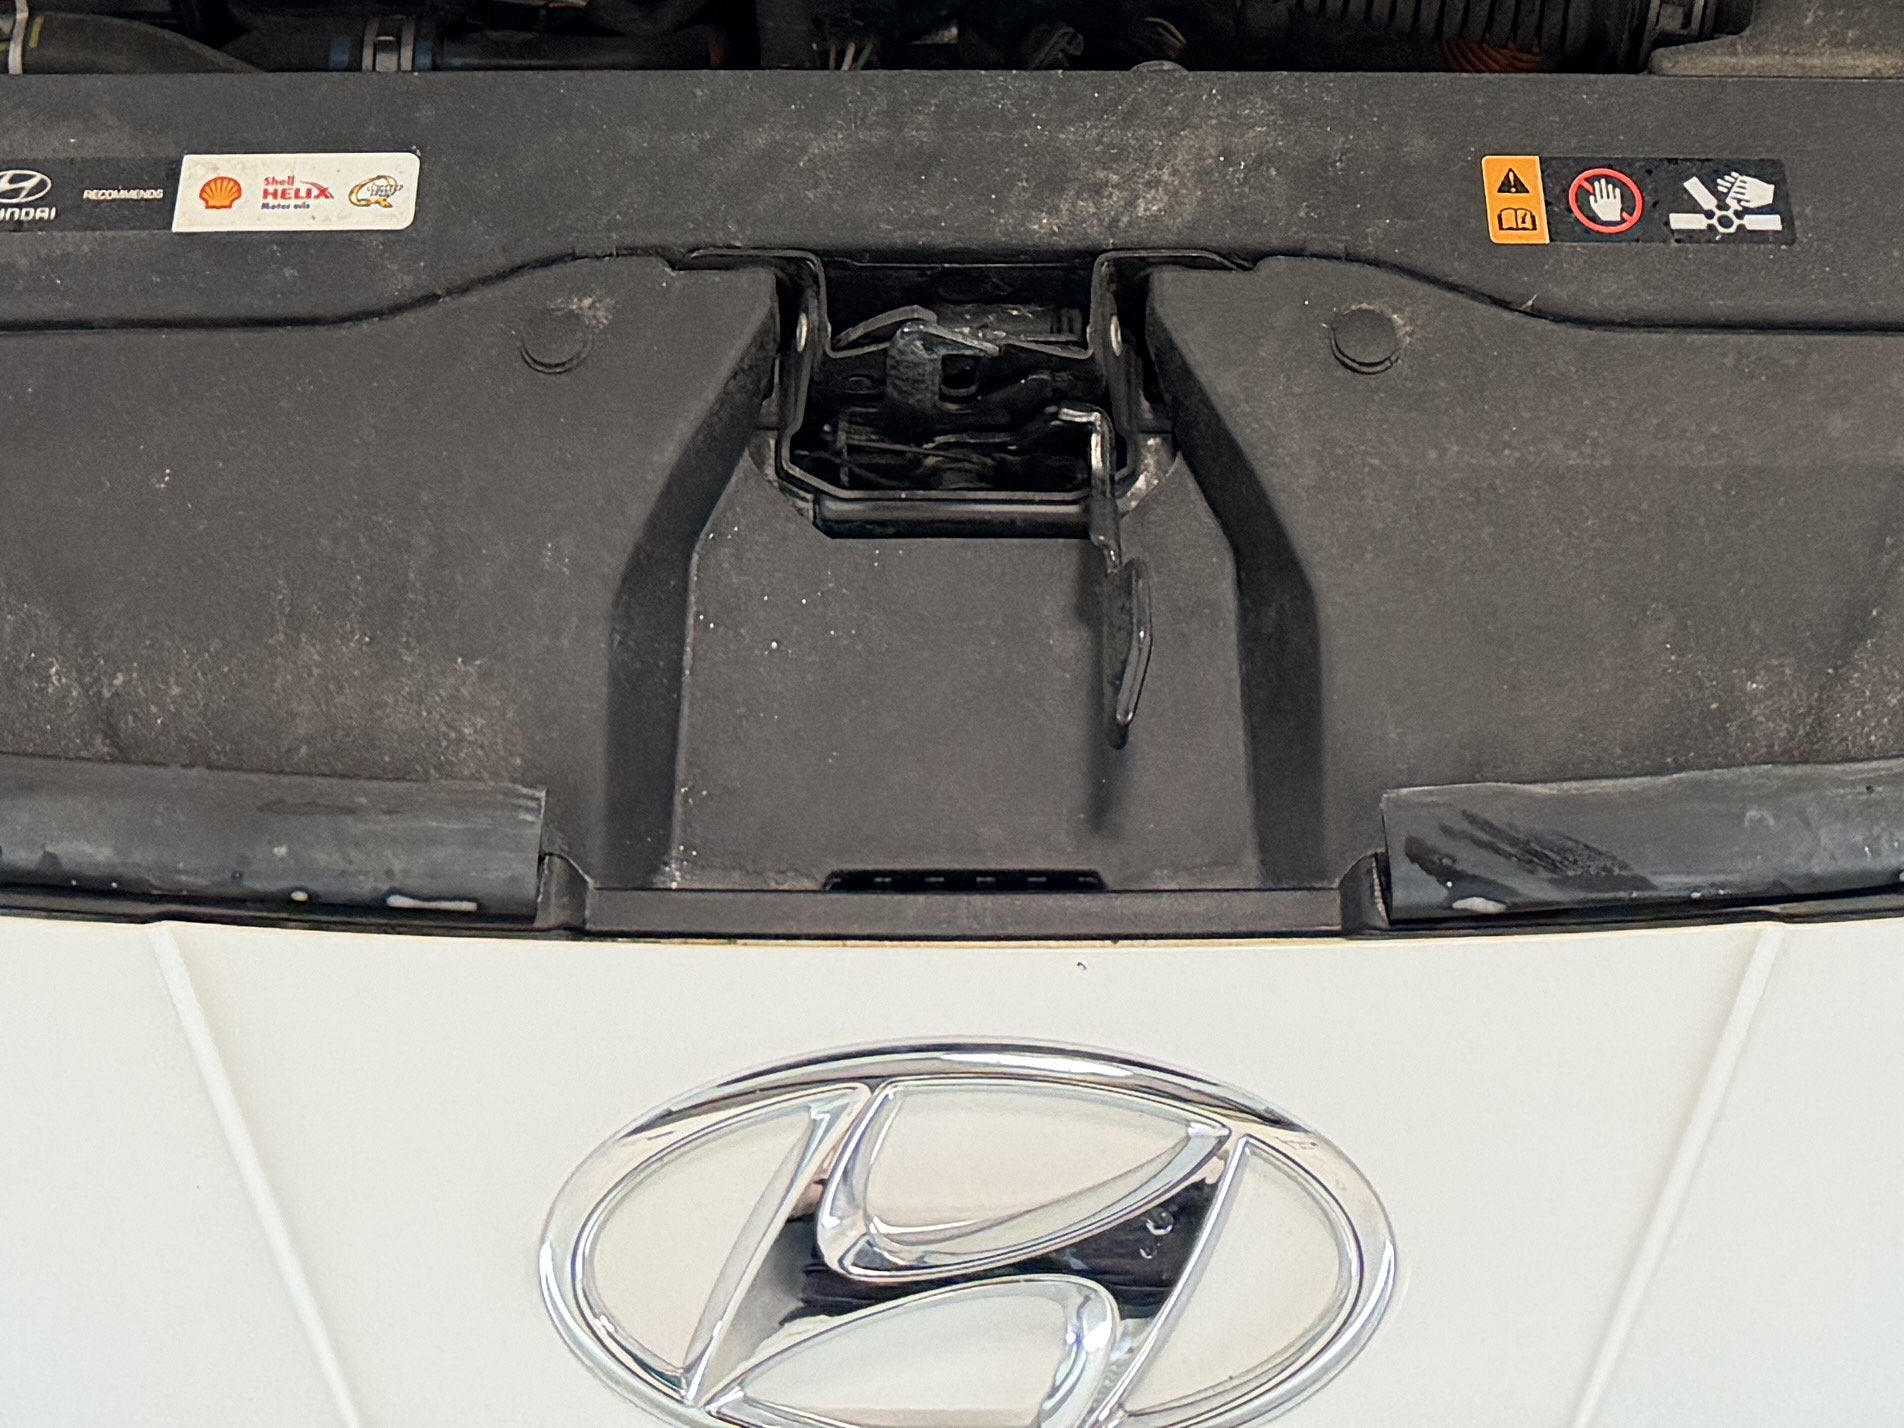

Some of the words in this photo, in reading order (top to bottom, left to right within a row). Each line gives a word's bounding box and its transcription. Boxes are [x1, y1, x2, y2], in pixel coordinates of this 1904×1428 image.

[264, 175, 295, 186] Shell
[83, 189, 164, 200] RECOMMENDS
[262, 187, 334, 201] HELIX
